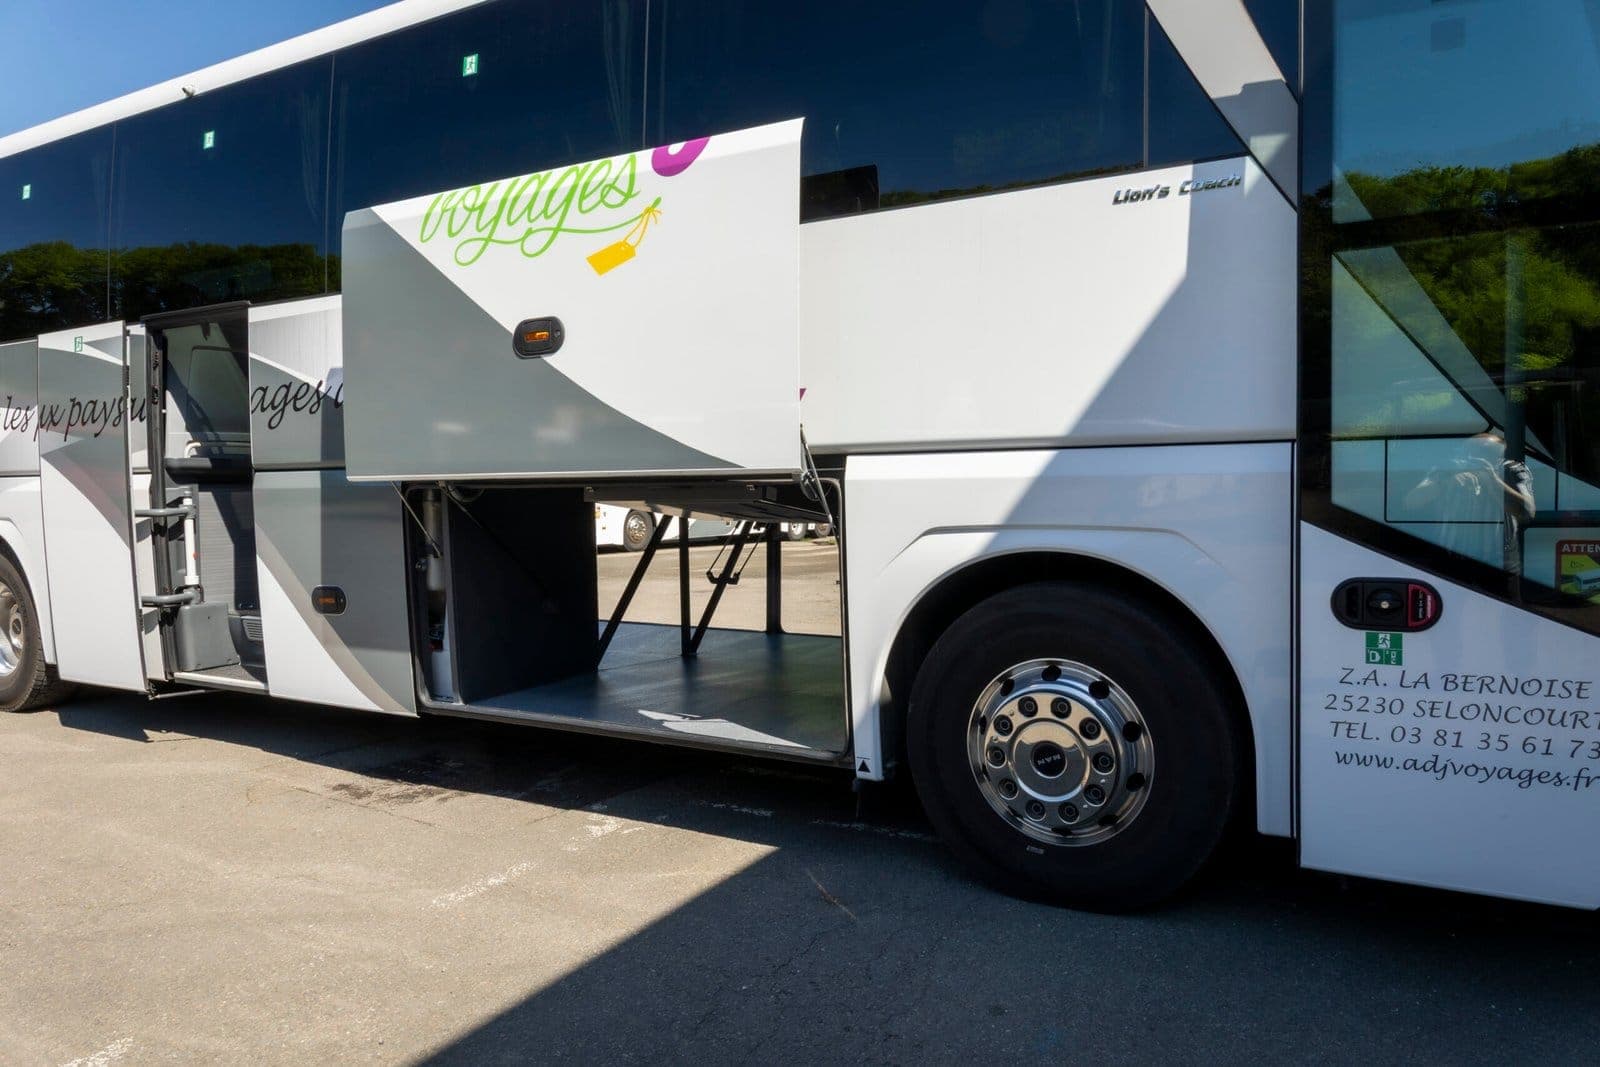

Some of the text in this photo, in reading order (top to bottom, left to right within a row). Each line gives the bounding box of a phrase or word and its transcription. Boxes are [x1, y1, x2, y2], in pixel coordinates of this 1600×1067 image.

[1112, 174, 1242, 205] Lion's Coach
[419, 153, 645, 267] voyages
[3, 395, 35, 433] les
[1338, 667, 1593, 700] Z.A. LA BERNOISE
[1324, 693, 1405, 715] 25230
[1330, 721, 1600, 760] TEL. 03 81 35 61 73
[1335, 750, 1600, 791] www.adjvoyages.fr
